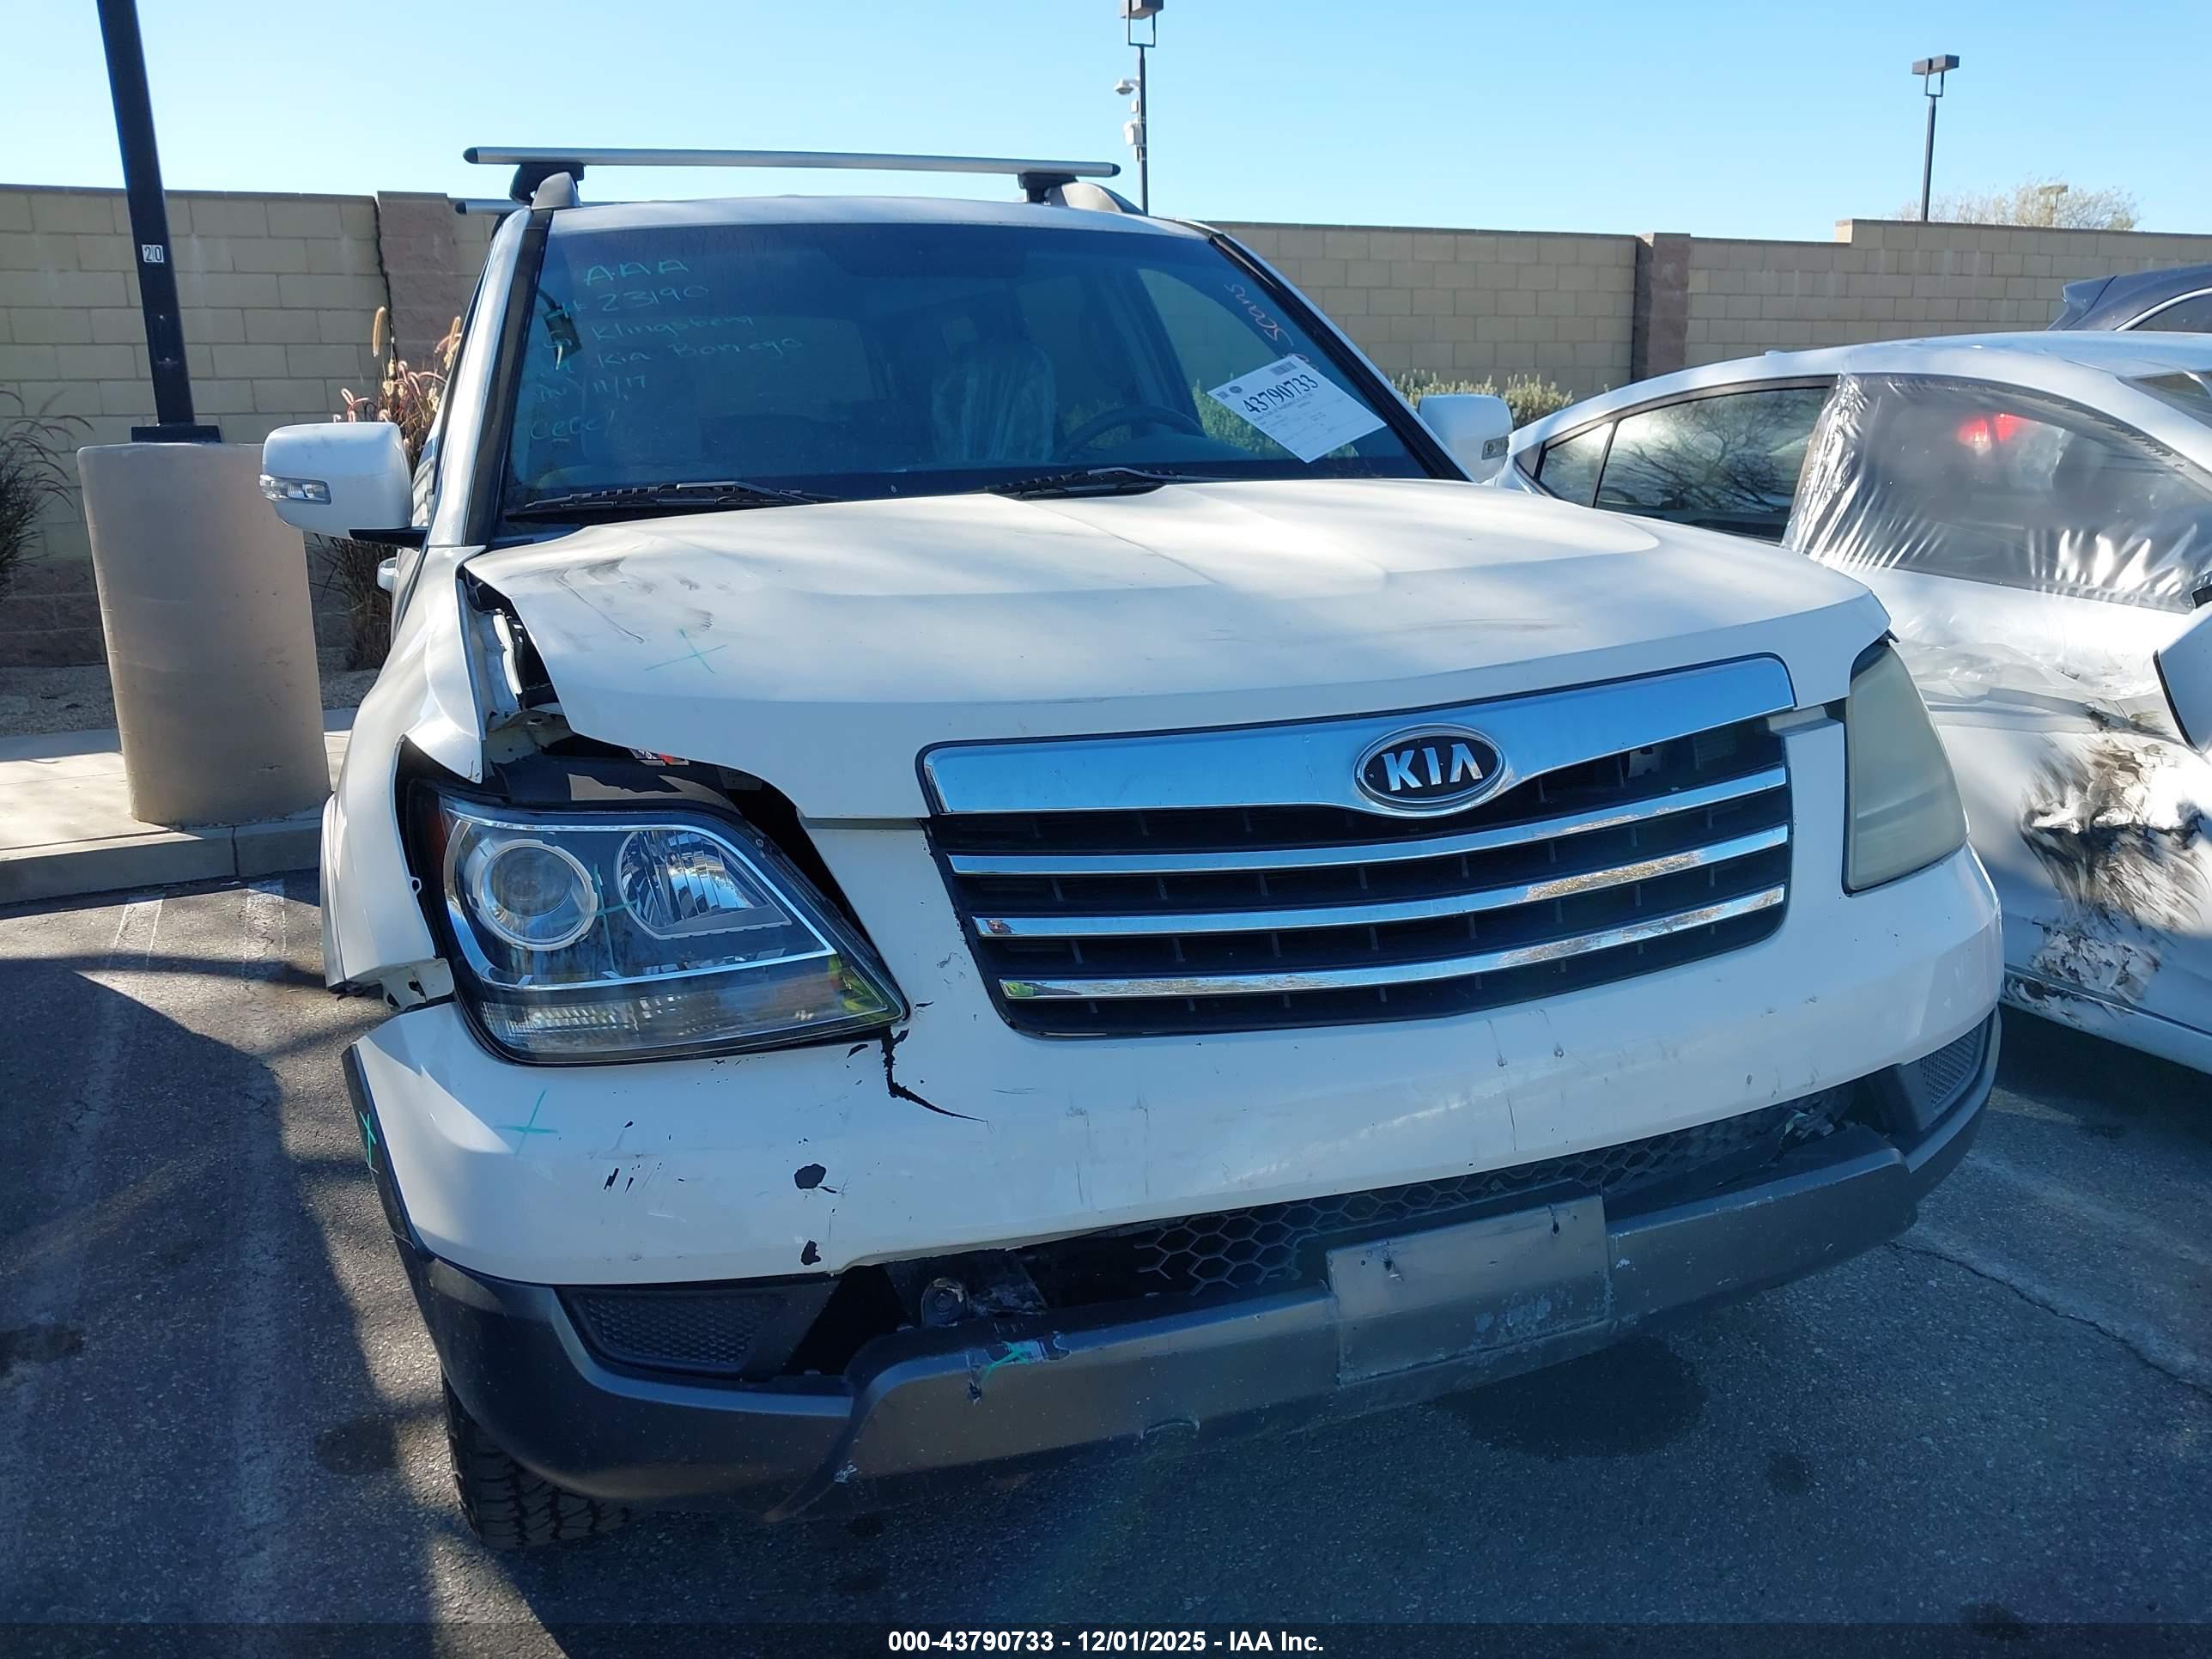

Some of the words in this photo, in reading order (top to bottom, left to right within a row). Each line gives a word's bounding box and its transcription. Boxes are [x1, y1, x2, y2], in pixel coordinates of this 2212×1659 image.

[144, 246, 162, 262] 20
[584, 258, 690, 287] AAA
[1243, 374, 1319, 414] 43790733
[1381, 743, 1484, 792] KIA
